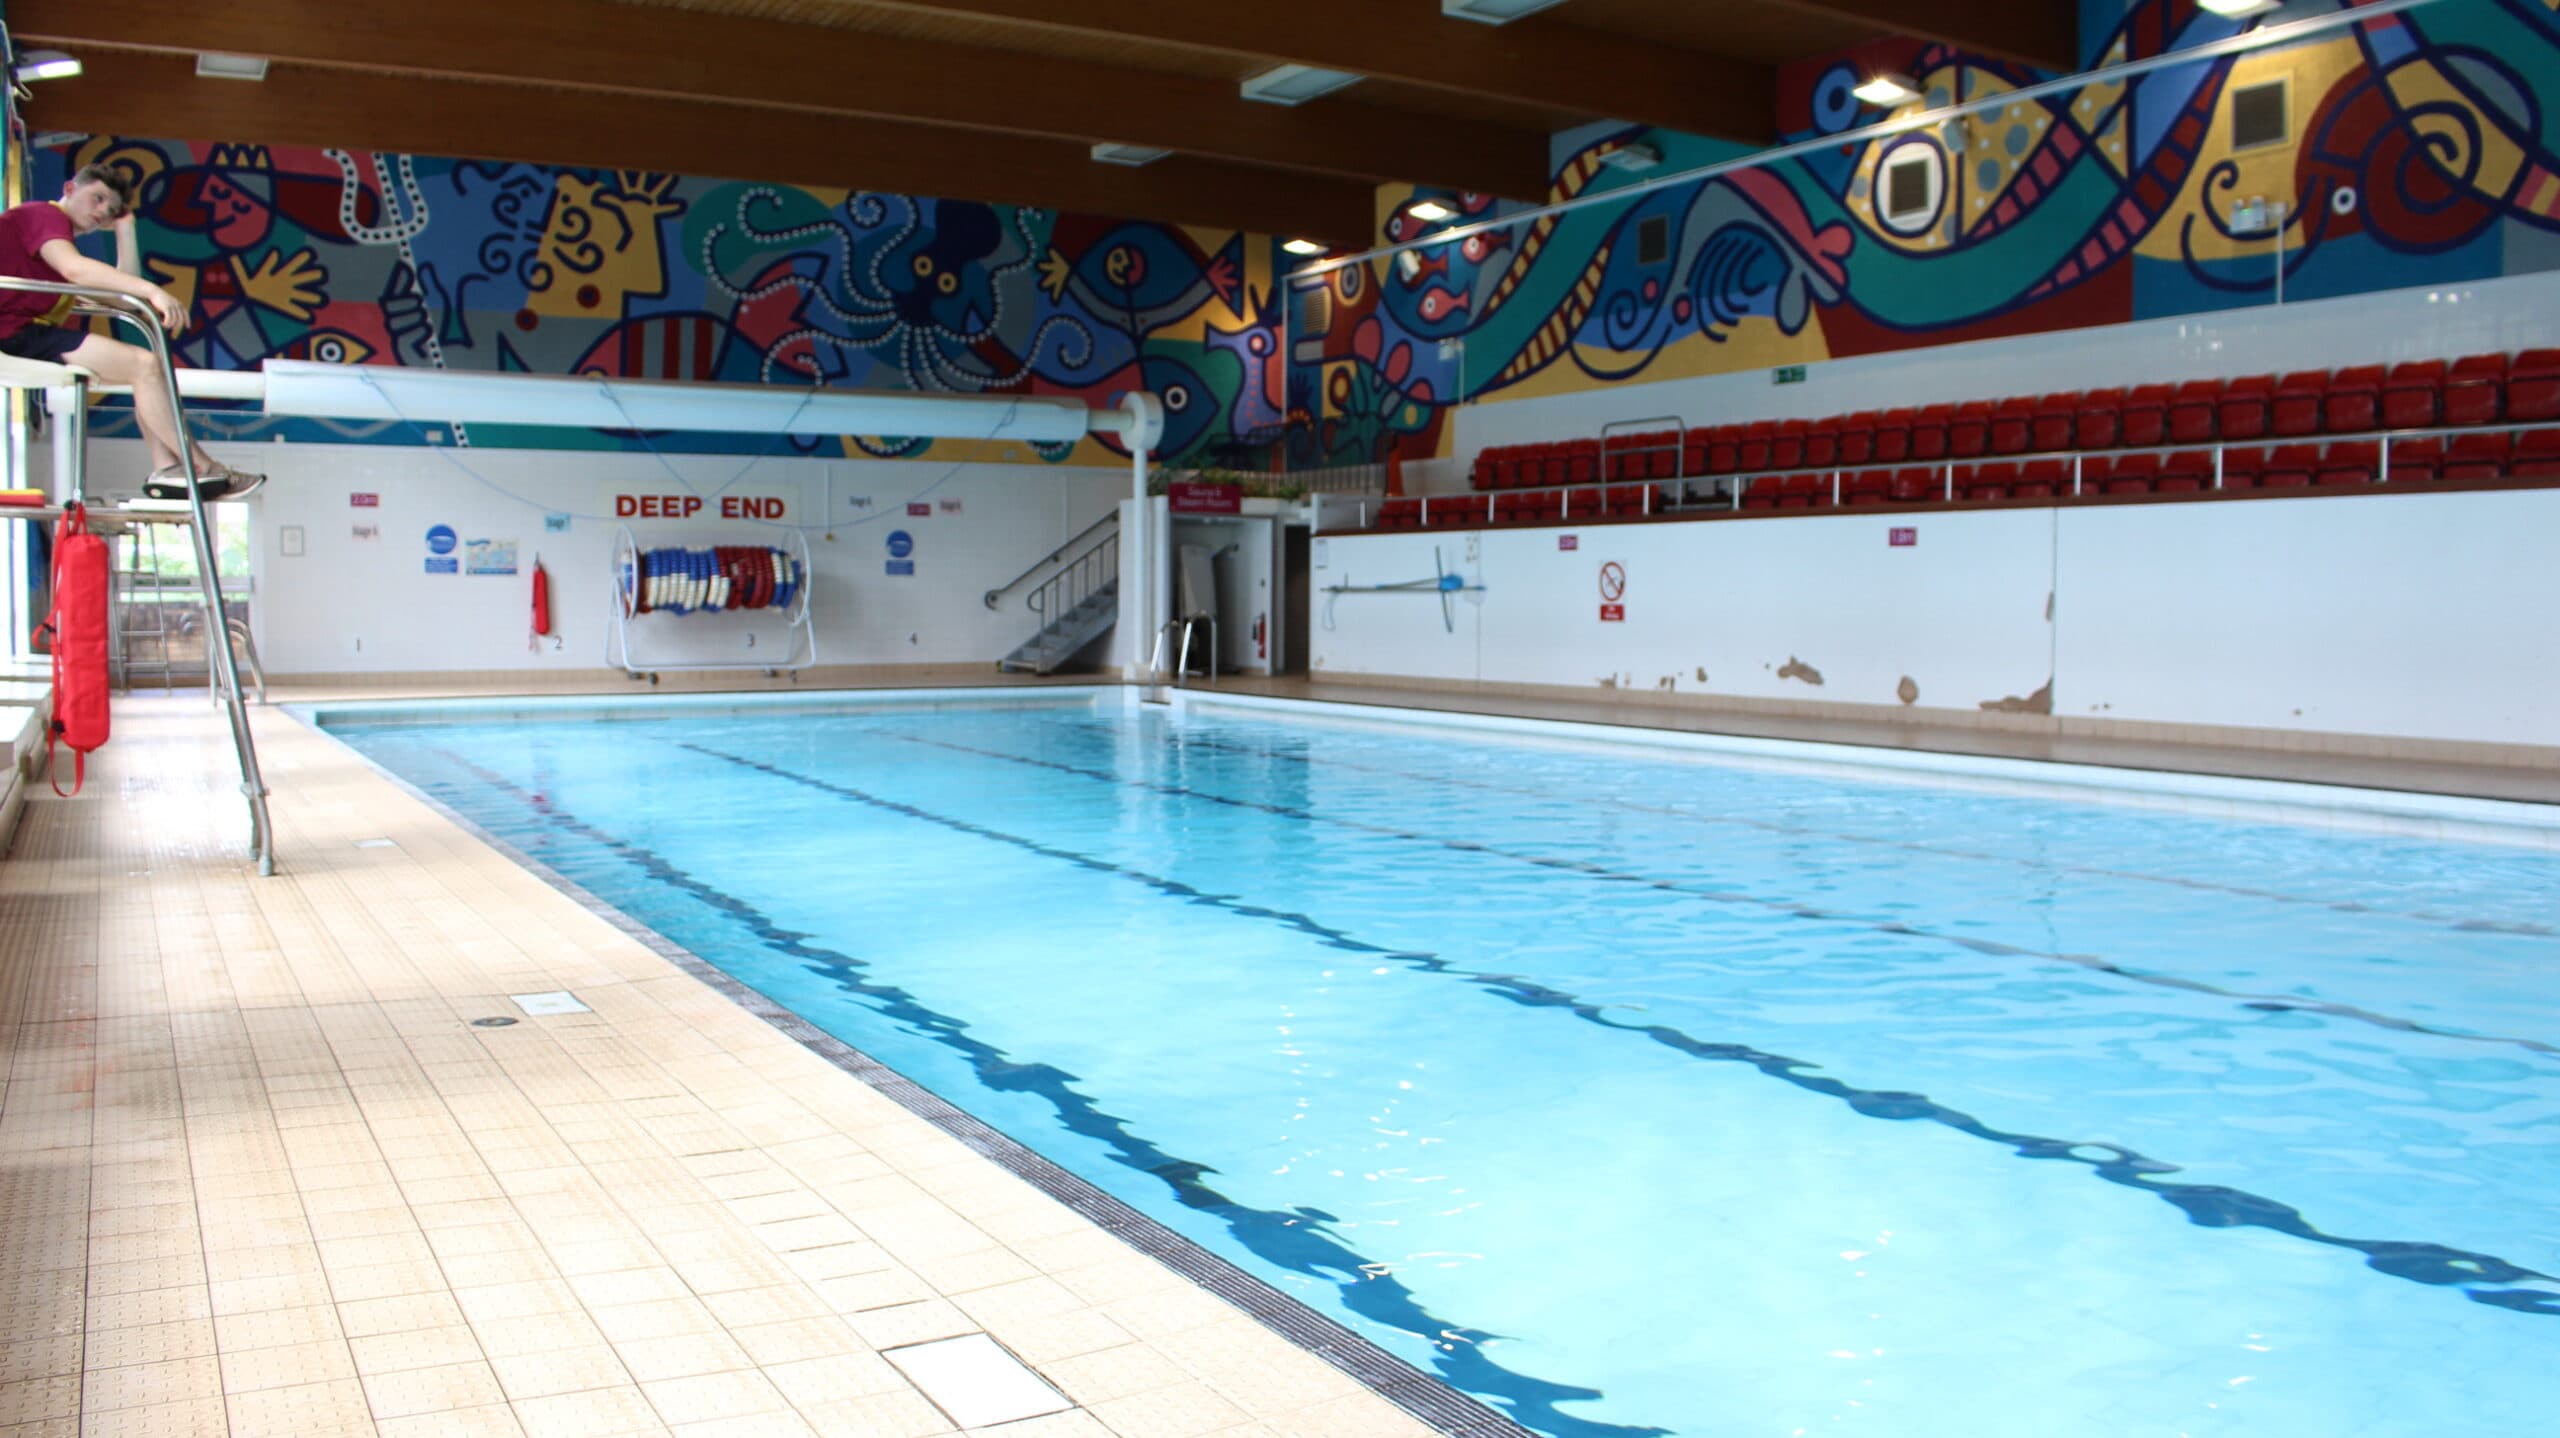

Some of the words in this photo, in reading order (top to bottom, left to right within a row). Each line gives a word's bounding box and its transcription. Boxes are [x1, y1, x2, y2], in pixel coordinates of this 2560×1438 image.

[616, 495, 703, 519] DEEP
[721, 496, 785, 519] END
[553, 635, 564, 651] 2
[746, 633, 756, 648] 3
[908, 632, 918, 646] 4
